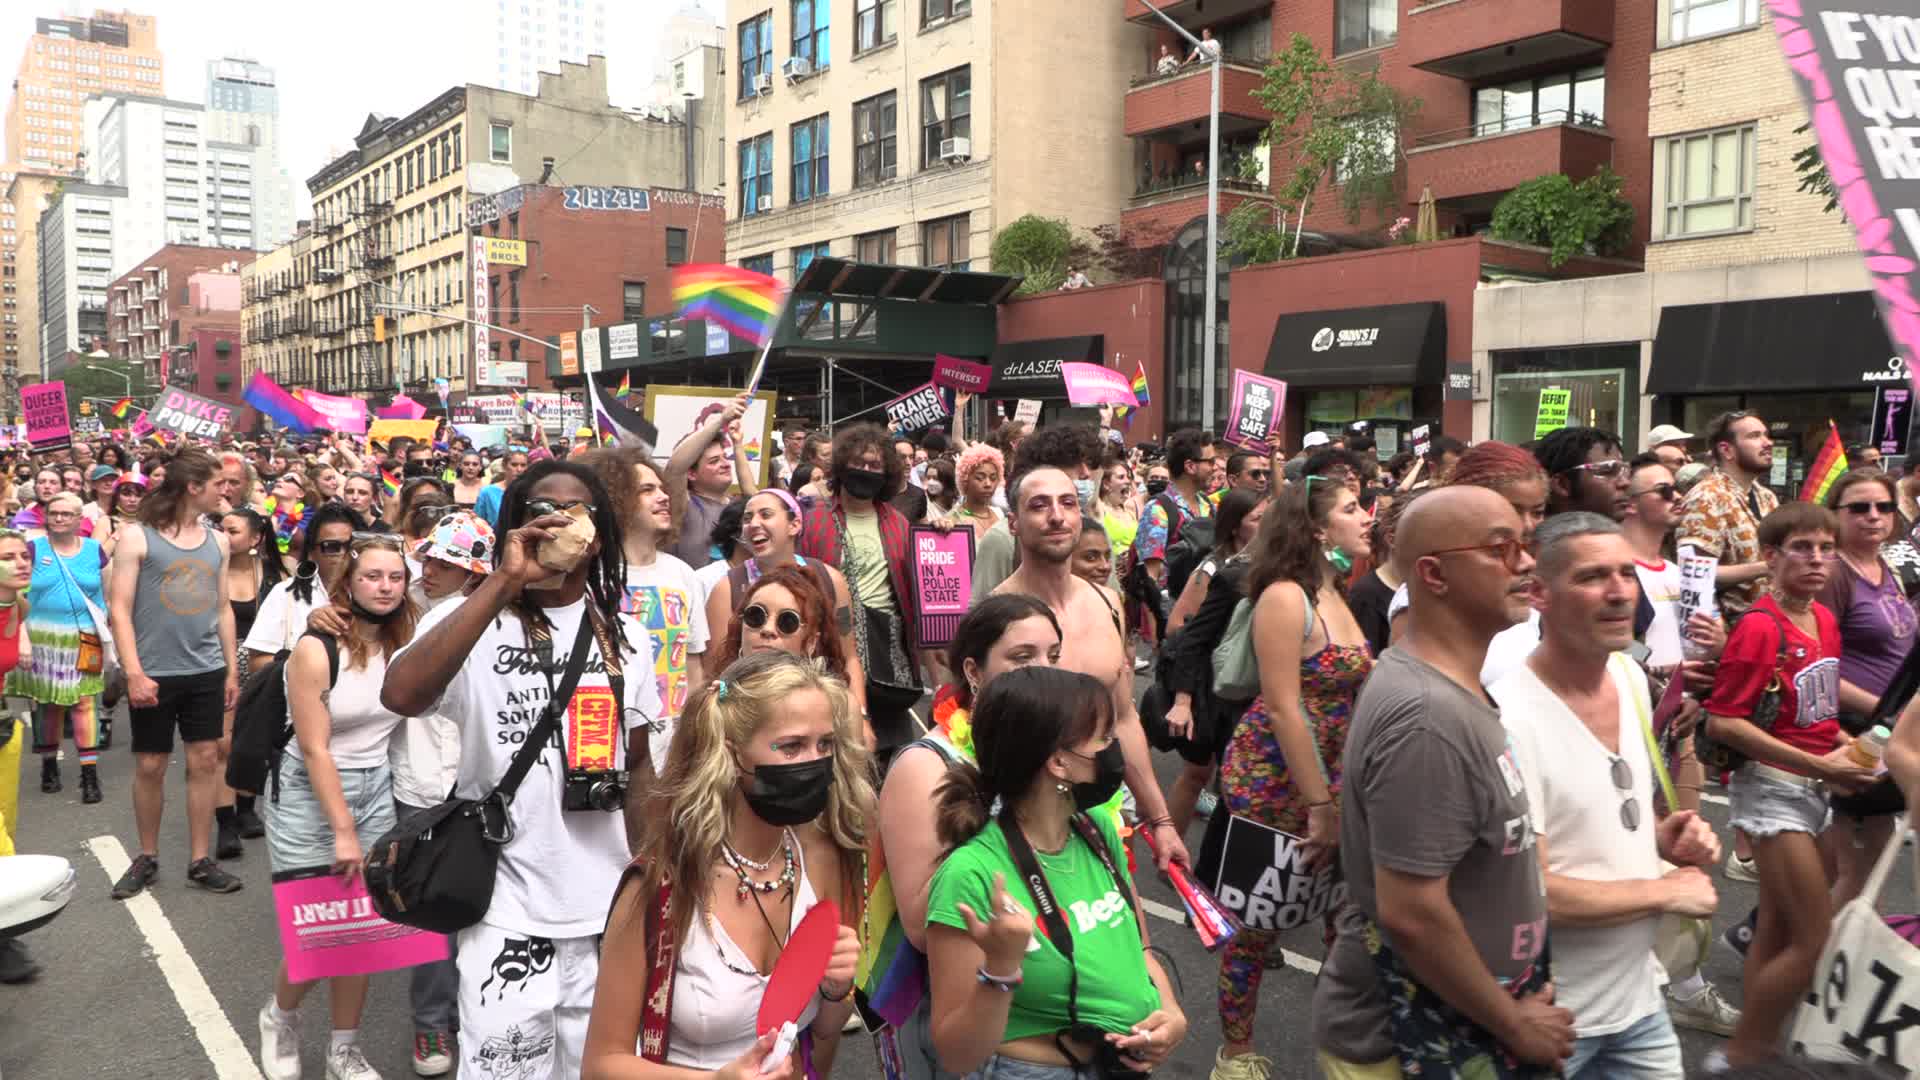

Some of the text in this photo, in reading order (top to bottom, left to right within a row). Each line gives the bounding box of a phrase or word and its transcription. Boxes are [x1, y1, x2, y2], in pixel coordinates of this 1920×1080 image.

[1820, 11, 1866, 61] IF
[491, 241, 519, 250] KOVE
[474, 240, 488, 381] HARDWARE
[940, 367, 982, 385] INTERSEX
[1251, 383, 1269, 398] WE
[1541, 393, 1567, 405] DEFEAT
[24, 391, 63, 410] QUEER
[165, 391, 232, 423] DYKE
[886, 386, 938, 420] TRANS
[1245, 394, 1272, 410] KEEP
[27, 416, 66, 433] MARCH
[156, 407, 221, 438] POWER
[895, 404, 946, 433] OWER
[1249, 408, 1264, 423] US
[1240, 417, 1267, 437] SAFE
[919, 538, 936, 551] NO
[919, 551, 956, 565] PRIDE
[922, 565, 945, 577] IN A
[923, 578, 961, 590] POLICE
[924, 590, 960, 603] STATE
[506, 687, 549, 706] ANTI
[1028, 874, 1054, 915] Canon
[292, 900, 349, 926] APART
[1220, 881, 1350, 930] PROUD
